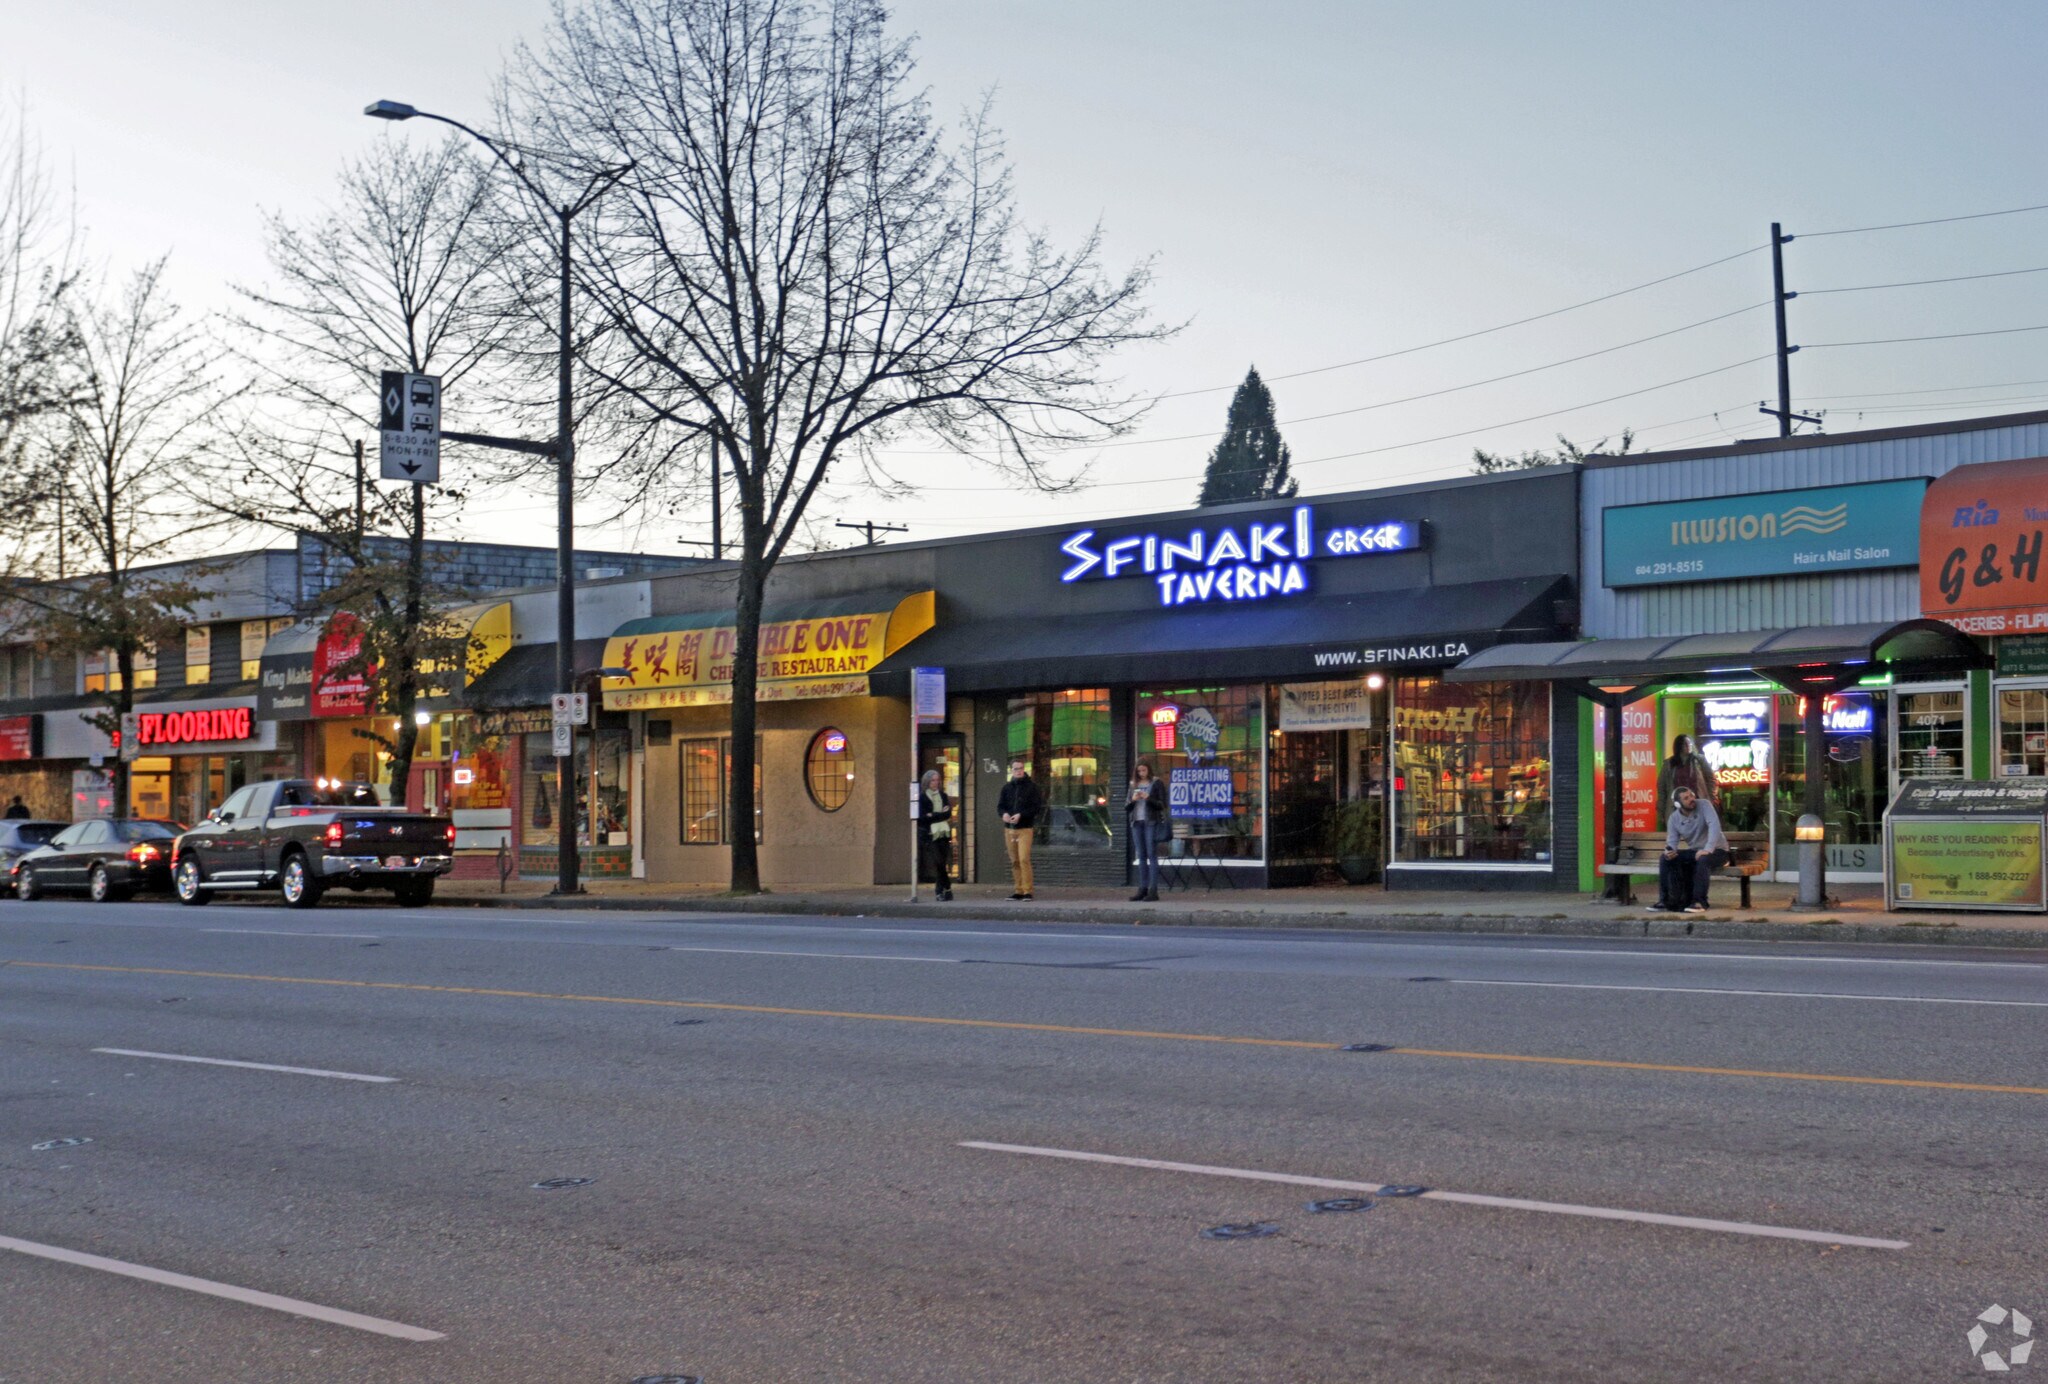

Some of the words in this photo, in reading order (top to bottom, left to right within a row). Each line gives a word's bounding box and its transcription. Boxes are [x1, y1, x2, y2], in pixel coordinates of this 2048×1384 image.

[387, 445, 434, 457] MON-FRI
[422, 437, 436, 447] AM
[1953, 499, 1999, 528] Ria
[1671, 512, 1777, 546] ILLUSION
[1061, 507, 1309, 582] SFINAKI
[1327, 526, 1402, 553] GREEK
[1793, 551, 1819, 565] Hair
[1818, 554, 1826, 563] &
[1827, 548, 1851, 563] Nail
[1854, 547, 1890, 560] Salon
[1635, 565, 1652, 576] 604
[1653, 560, 1704, 575] 291-8515
[1939, 547, 1967, 605] G
[1973, 543, 2003, 587] &
[2010, 530, 2043, 583] H
[1157, 563, 1305, 606] TAVERNA
[2015, 612, 2048, 630] FILIPI
[710, 623, 810, 661] DBLE
[815, 618, 872, 652] ONE
[1314, 643, 1470, 667] WWW.SFINAKI.CA
[771, 655, 869, 677] RESTAURANT
[263, 669, 286, 691] King
[141, 707, 250, 744] FLOORING
[1152, 710, 1176, 724] OPEN
[1832, 708, 1867, 729] Nail
[1916, 715, 1945, 726] 4071
[509, 720, 552, 734] ALTERA
[1631, 750, 1655, 767] NAIL
[1172, 769, 1229, 783] CELEBRATING
[1713, 768, 1770, 784] ASSAGE
[1173, 785, 1187, 802] 20
[1190, 783, 1231, 803] YEARS!
[1911, 788, 1937, 798] Curb
[1936, 790, 1961, 799] your
[1962, 788, 1995, 798] waste
[1996, 788, 2005, 797] &
[2006, 787, 2048, 800] recycle
[1896, 835, 1917, 844] WHY
[1919, 835, 1939, 844] ARE
[1942, 835, 1963, 844] YOU
[1964, 835, 2008, 845] READING
[2011, 835, 2039, 845] THIS?
[1907, 848, 1944, 857] Because
[1946, 848, 1995, 859] Advertising
[1997, 848, 2028, 858] Works.
